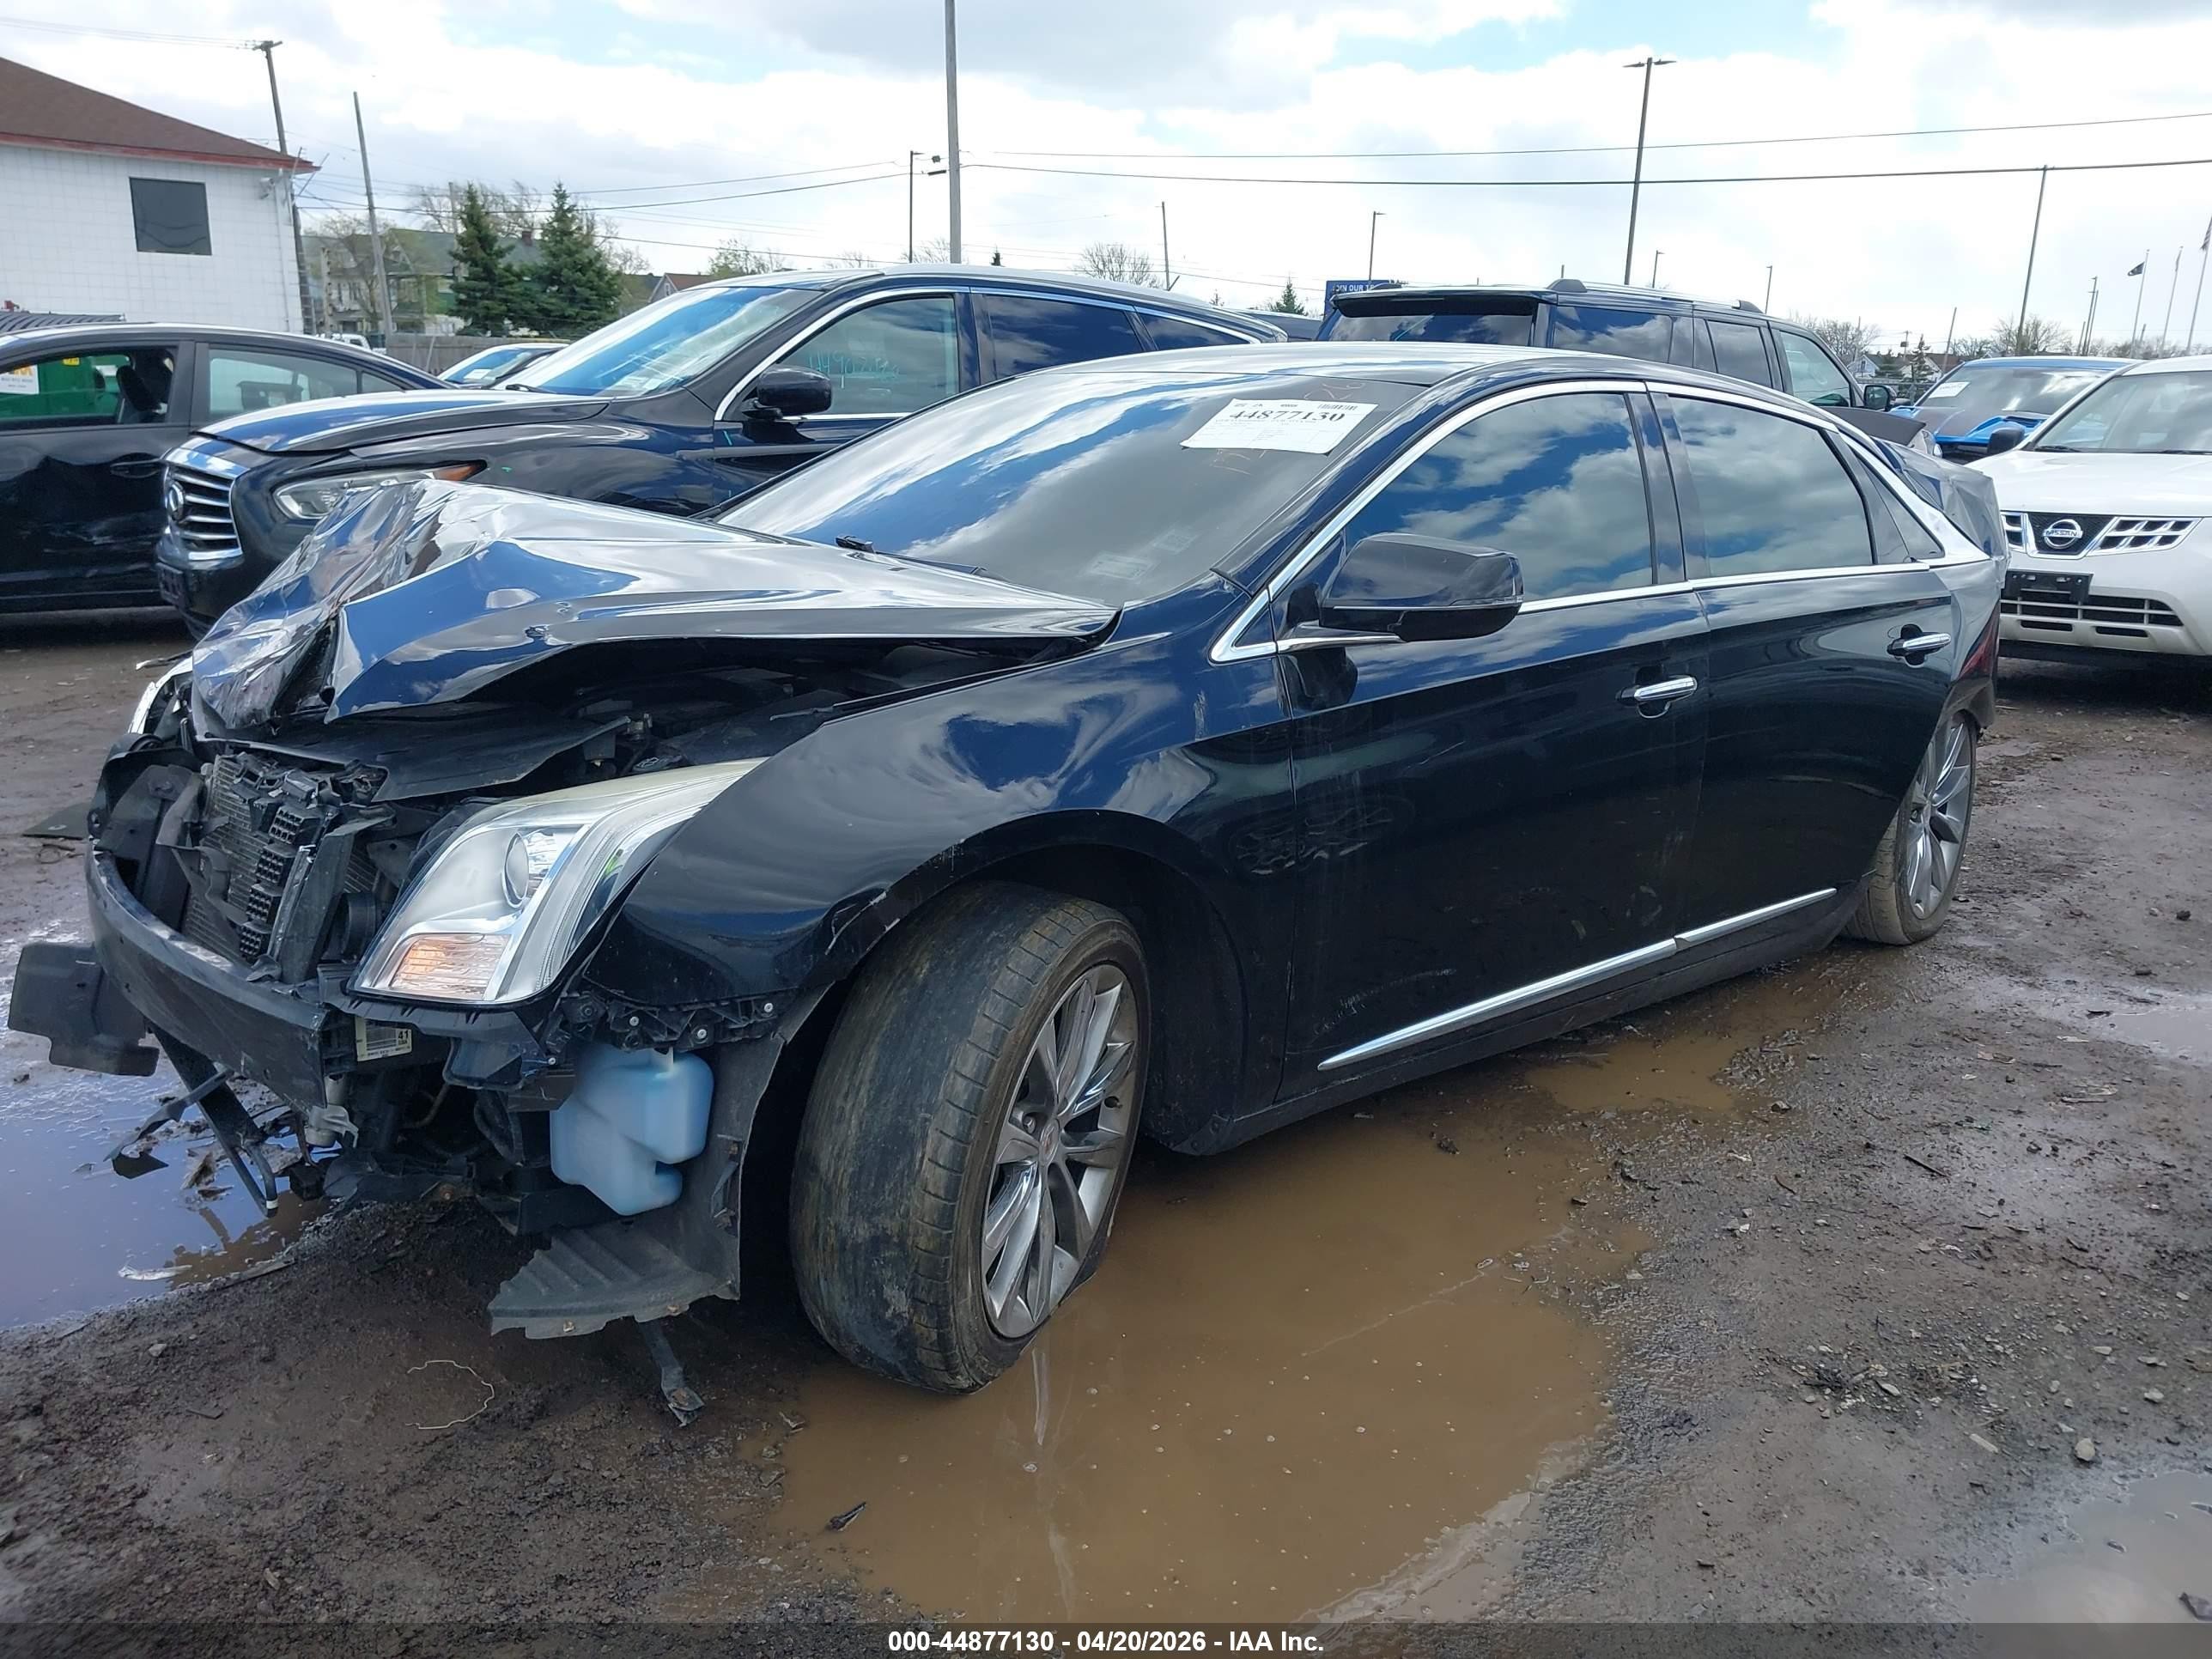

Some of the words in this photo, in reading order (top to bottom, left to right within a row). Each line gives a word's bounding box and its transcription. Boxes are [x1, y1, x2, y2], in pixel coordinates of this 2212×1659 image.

[1229, 410, 1346, 422] 44877130
[2045, 529, 2079, 538] NISSAN
[398, 1030, 409, 1040] 41
